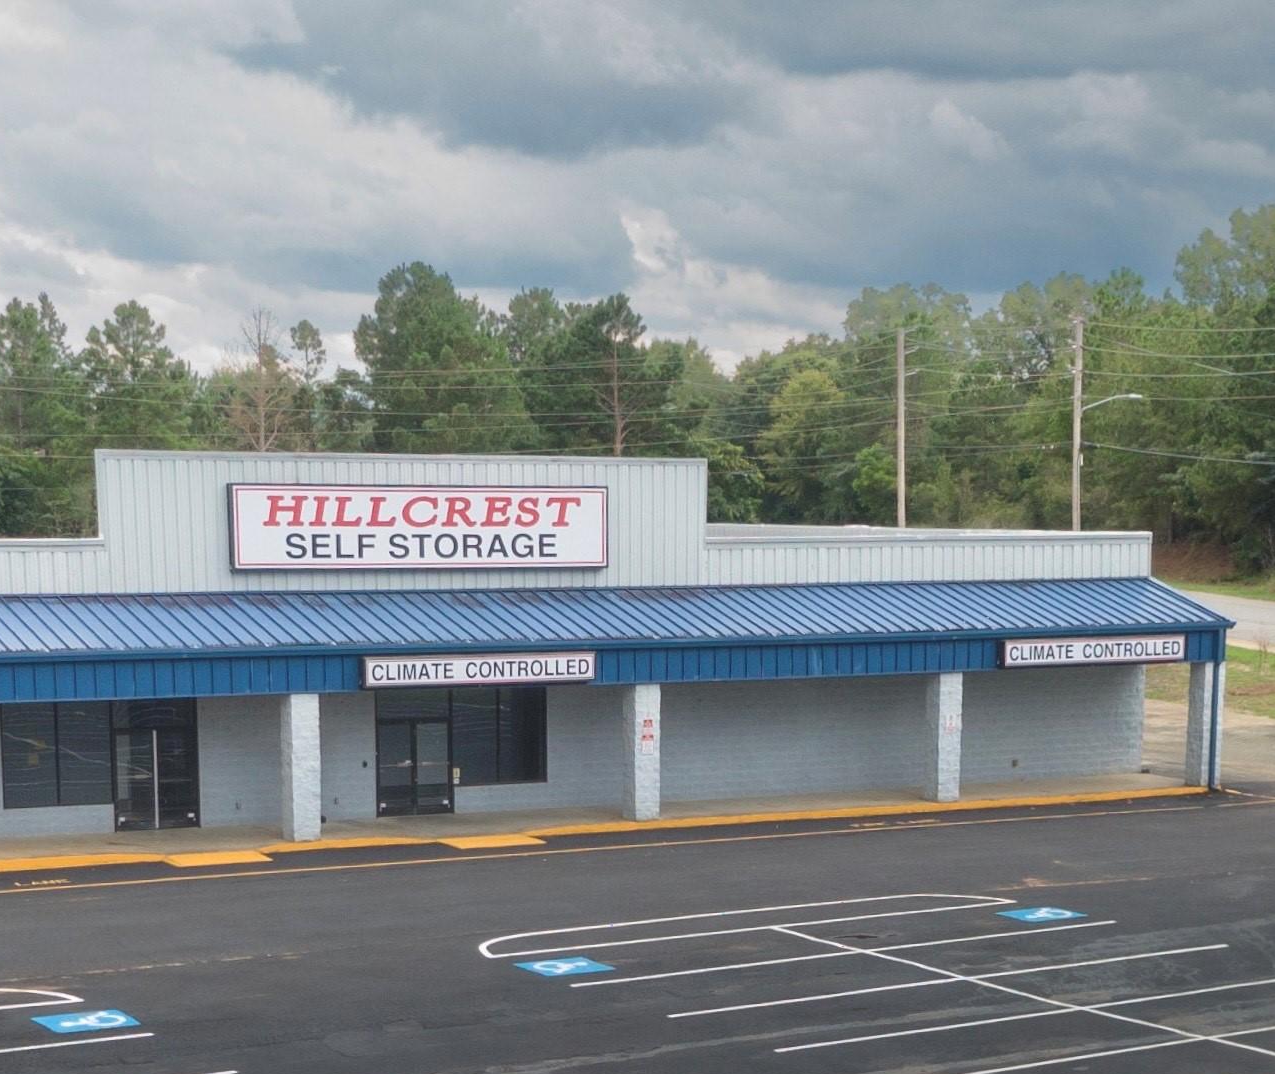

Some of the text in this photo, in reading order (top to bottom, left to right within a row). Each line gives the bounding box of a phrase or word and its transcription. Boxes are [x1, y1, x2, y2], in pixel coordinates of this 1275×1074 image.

[262, 495, 581, 528] HILLCREST
[285, 533, 558, 560] SELF STORAGE
[1009, 641, 1181, 661] CLIMATE CONTROLLED
[371, 659, 590, 681] CLIMATE CONTROLLED
